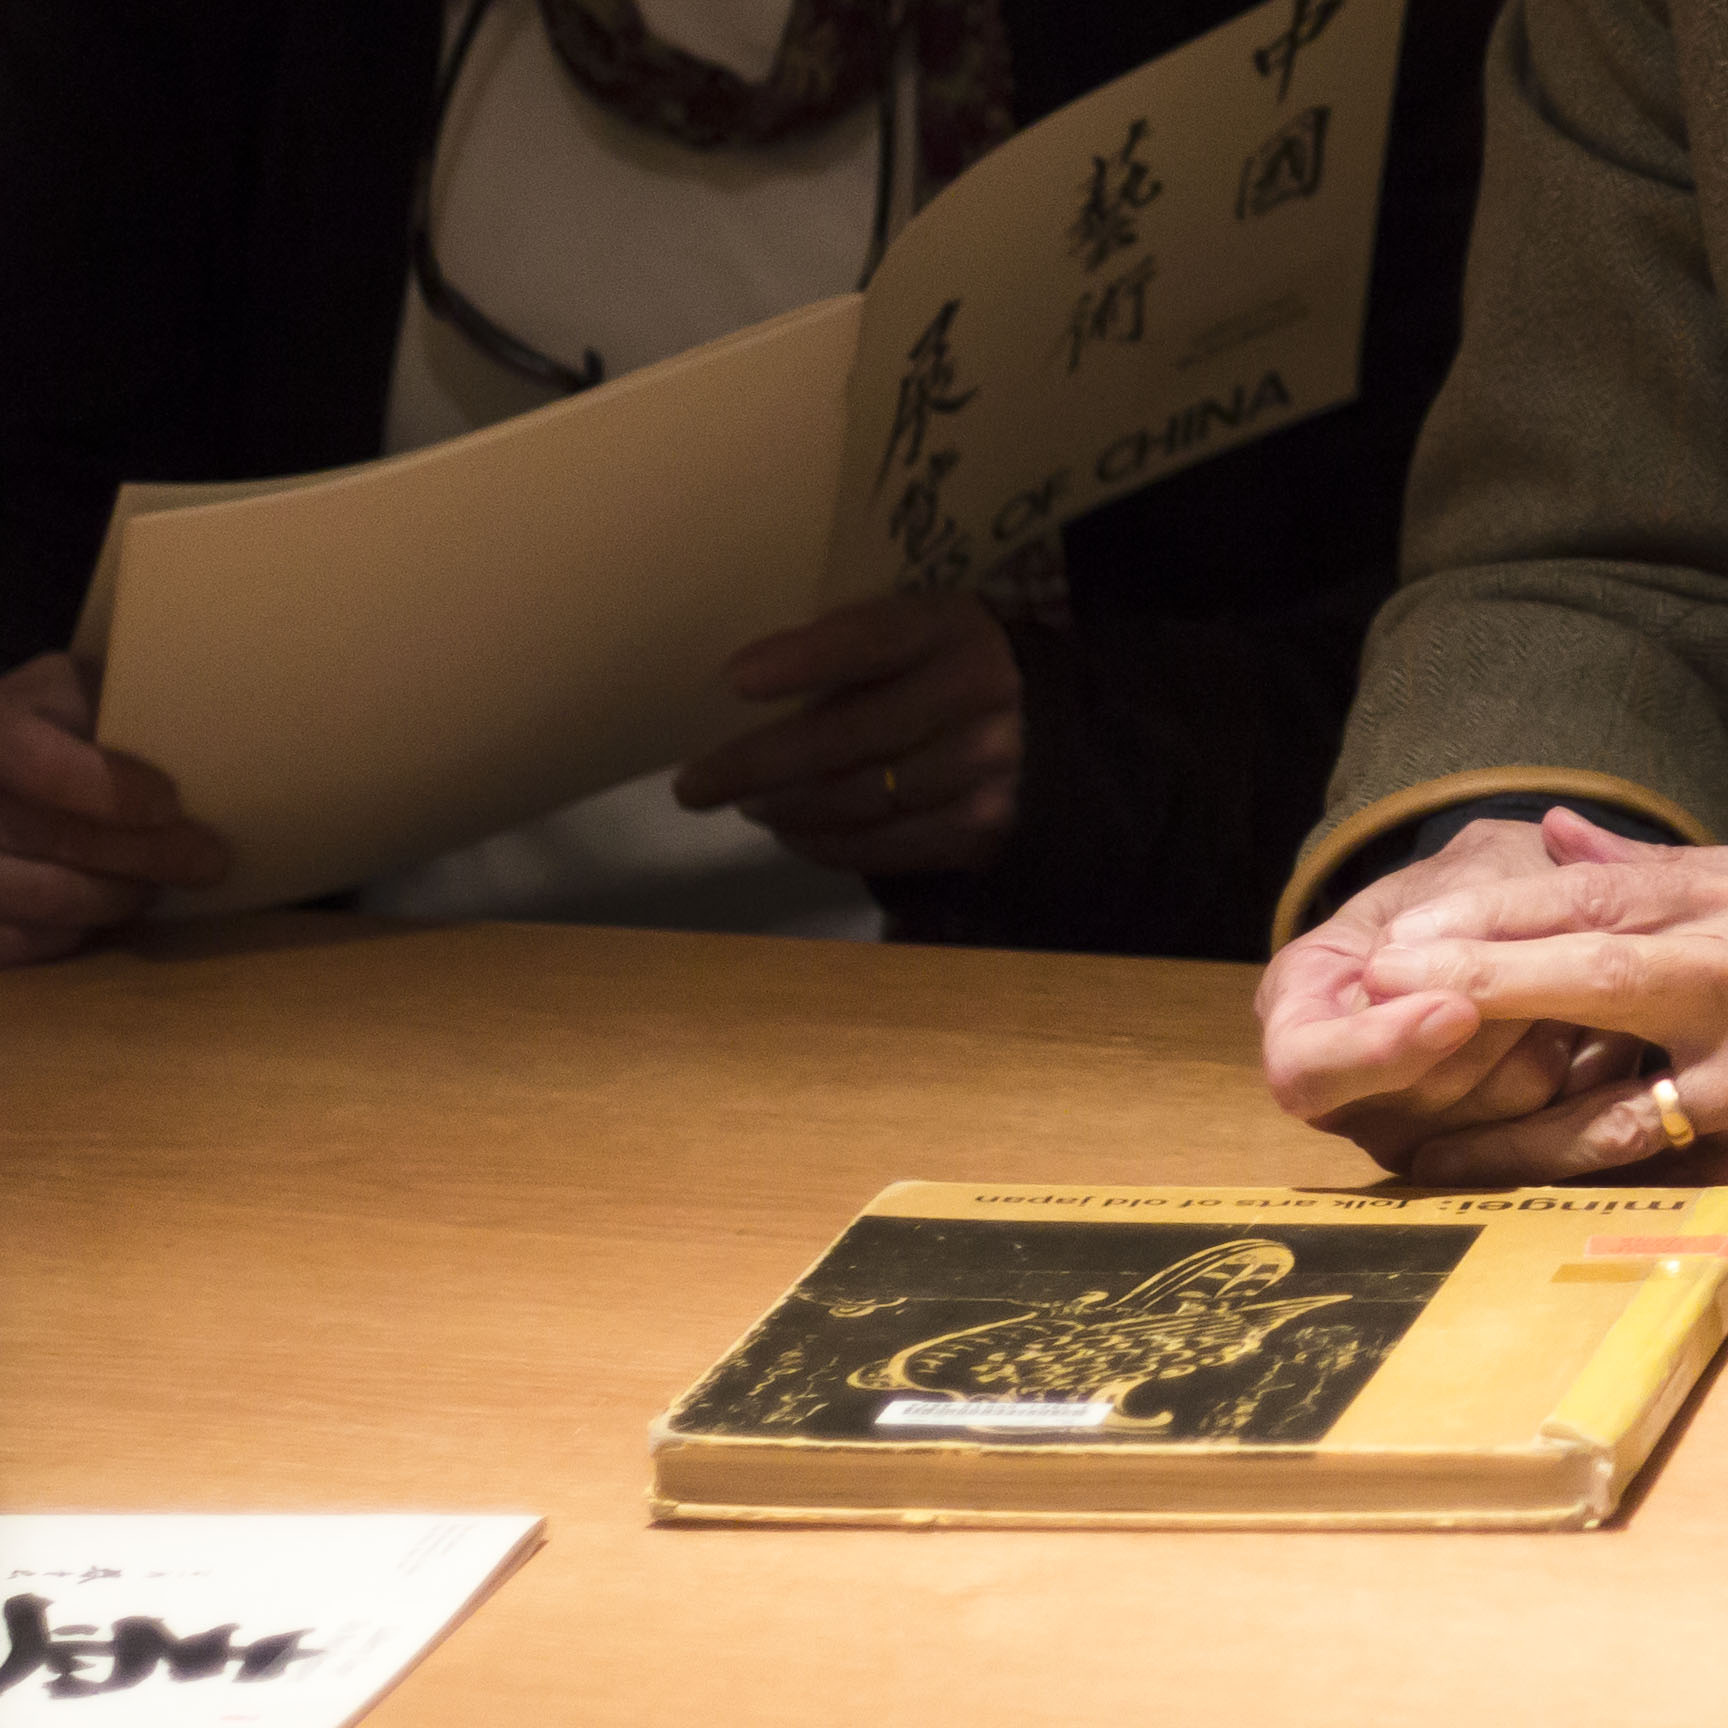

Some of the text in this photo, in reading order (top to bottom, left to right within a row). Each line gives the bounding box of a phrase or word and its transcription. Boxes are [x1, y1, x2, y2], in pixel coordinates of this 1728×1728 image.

[992, 467, 1070, 542] OF
[1096, 372, 1293, 483] CHINA
[974, 1193, 1687, 1215] mingei: folk arts of old japan
